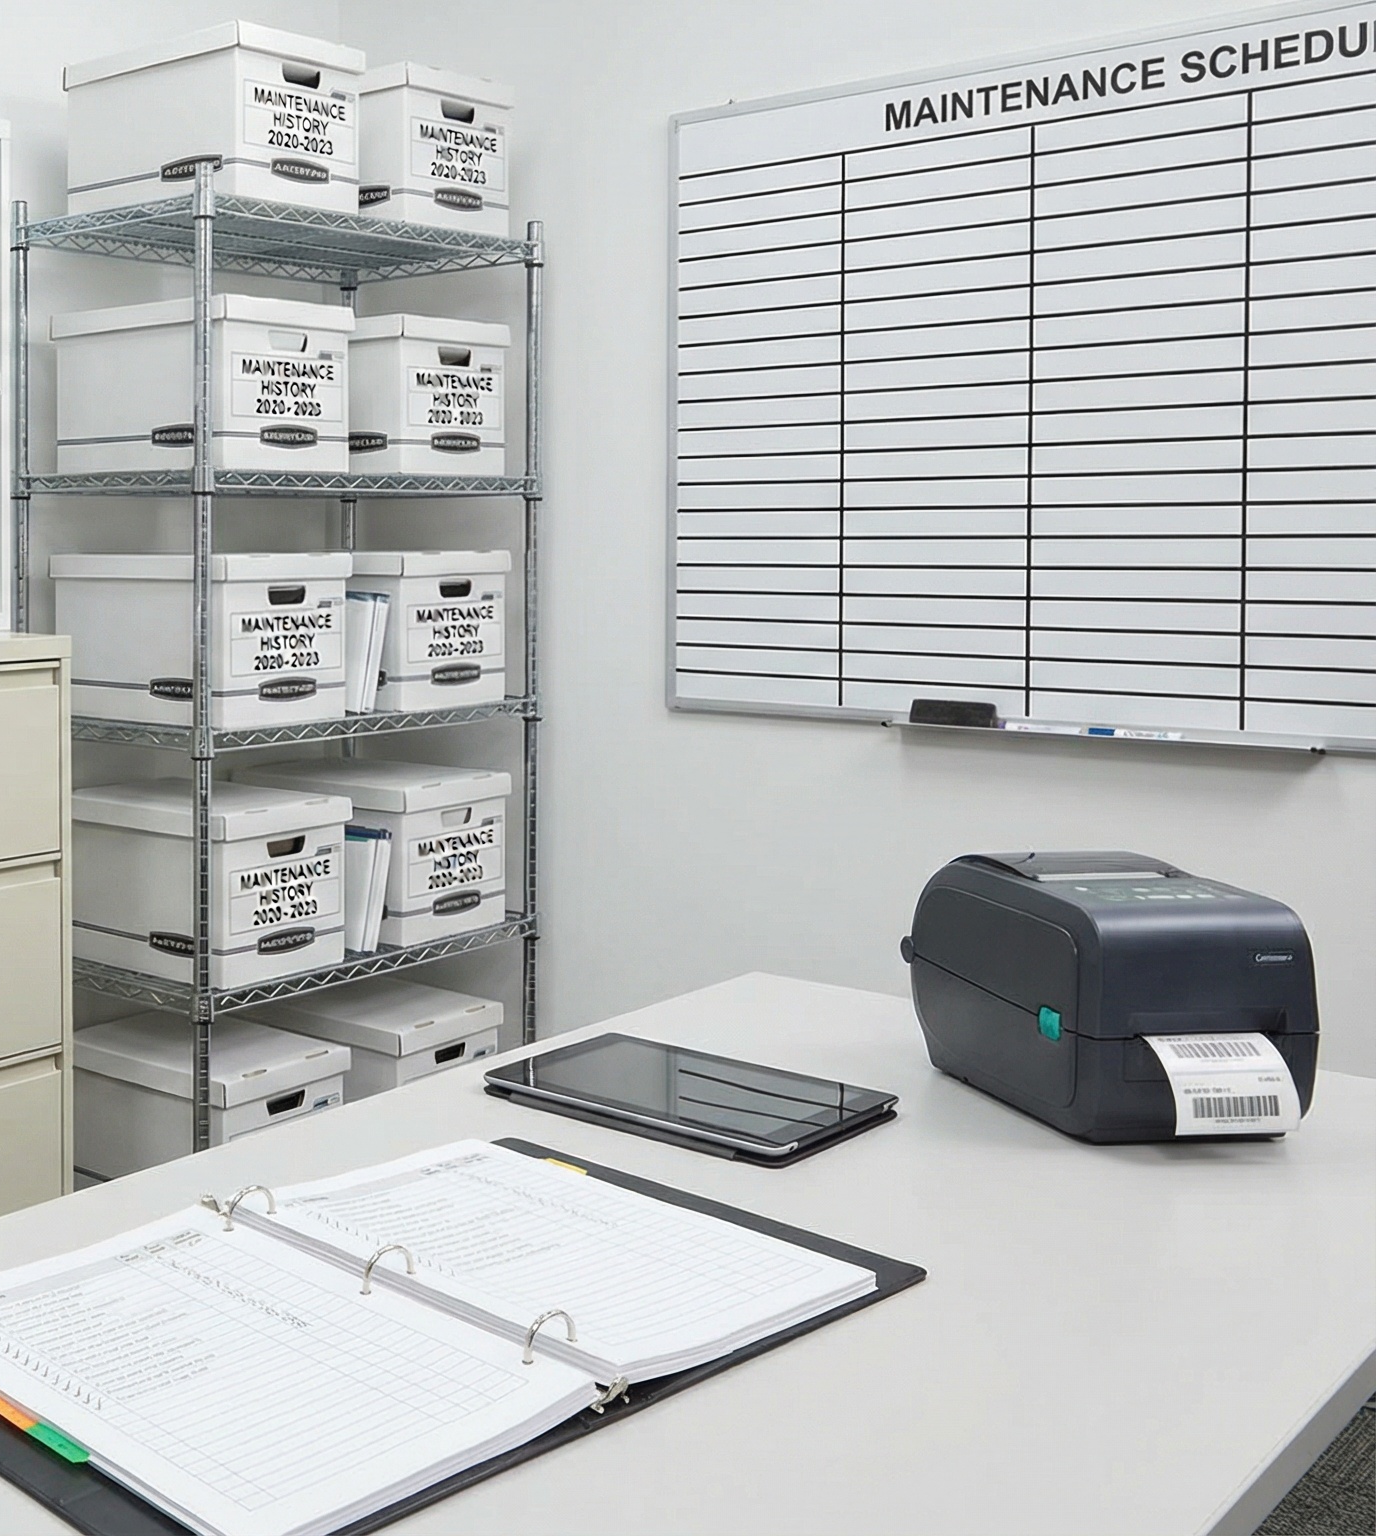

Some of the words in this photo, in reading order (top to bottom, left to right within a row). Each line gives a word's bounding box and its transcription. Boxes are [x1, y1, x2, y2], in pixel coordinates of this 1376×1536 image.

[884, 57, 1166, 132] MAINTENANCE
[1180, 20, 1376, 84] SCHEDU
[253, 87, 346, 121] MAINTENANCE
[273, 111, 329, 136] HISTORY
[267, 130, 334, 156] 2020-2023
[260, 380, 317, 398] HISTORY
